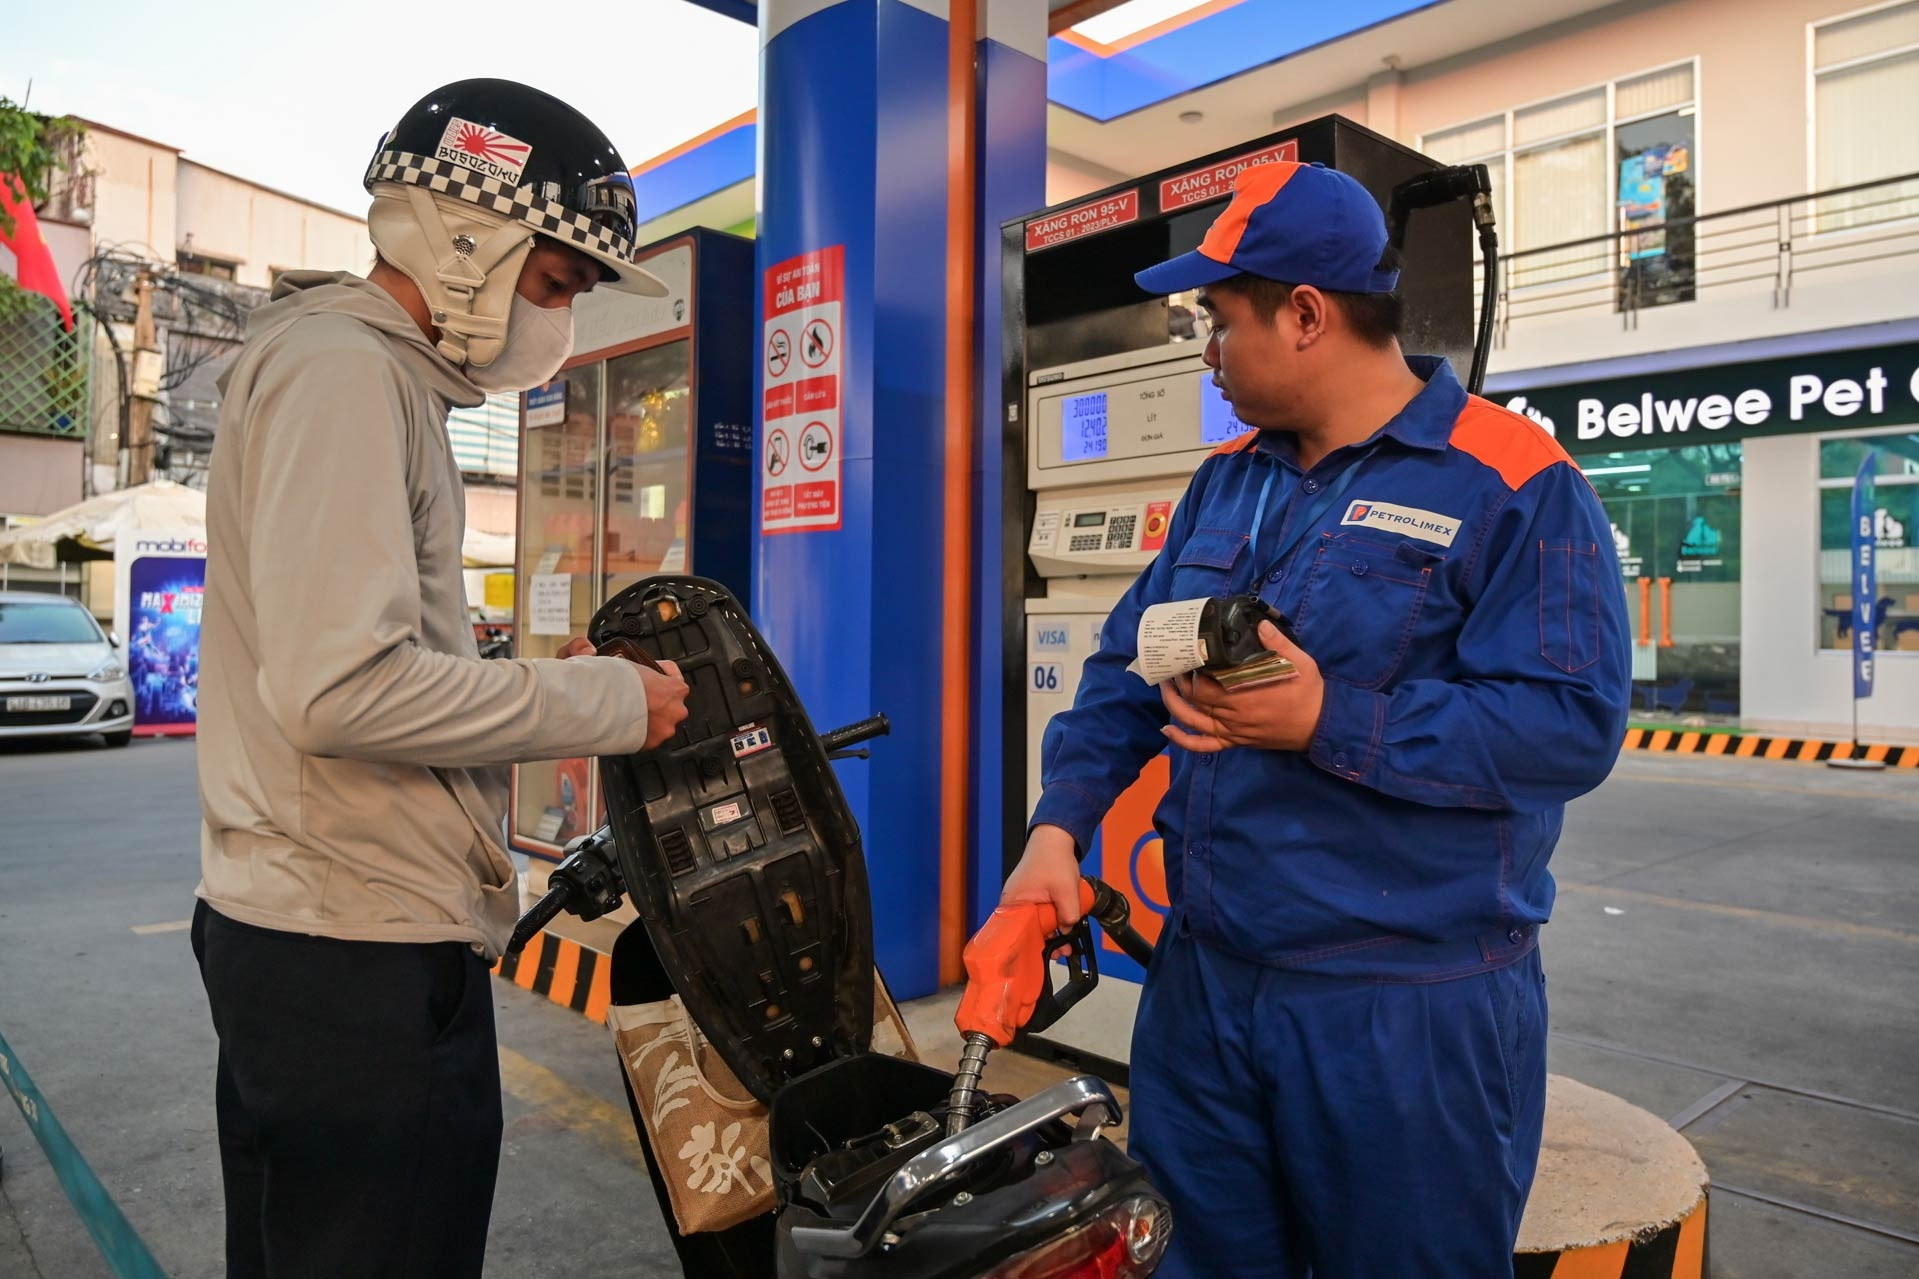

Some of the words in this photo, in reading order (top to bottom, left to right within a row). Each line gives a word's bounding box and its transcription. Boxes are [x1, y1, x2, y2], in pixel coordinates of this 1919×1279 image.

[439, 147, 519, 184] BOSOZOKU
[1171, 173, 1211, 196] XĂNG
[1215, 162, 1247, 182] RON
[1182, 188, 1207, 203] TCCS
[1209, 185, 1219, 196] 01
[1034, 217, 1067, 237] XĂNG
[1070, 208, 1097, 225] RON
[1101, 199, 1128, 216] 95-V
[1043, 231, 1065, 244] TCCS
[1066, 228, 1075, 237] 01
[1081, 215, 1118, 233] 2023/PLX
[776, 285, 795, 309] CỦA
[797, 281, 820, 303] BẠN
[1073, 394, 1107, 418] 300000
[1577, 388, 1772, 440] Belwee
[1790, 367, 1888, 420] Pet
[1147, 412, 1157, 423] LÍT
[1370, 510, 1452, 536] PETROLIMEX
[137, 538, 207, 553] mobifo
[1038, 630, 1066, 645] VISA
[1035, 666, 1057, 690] 06
